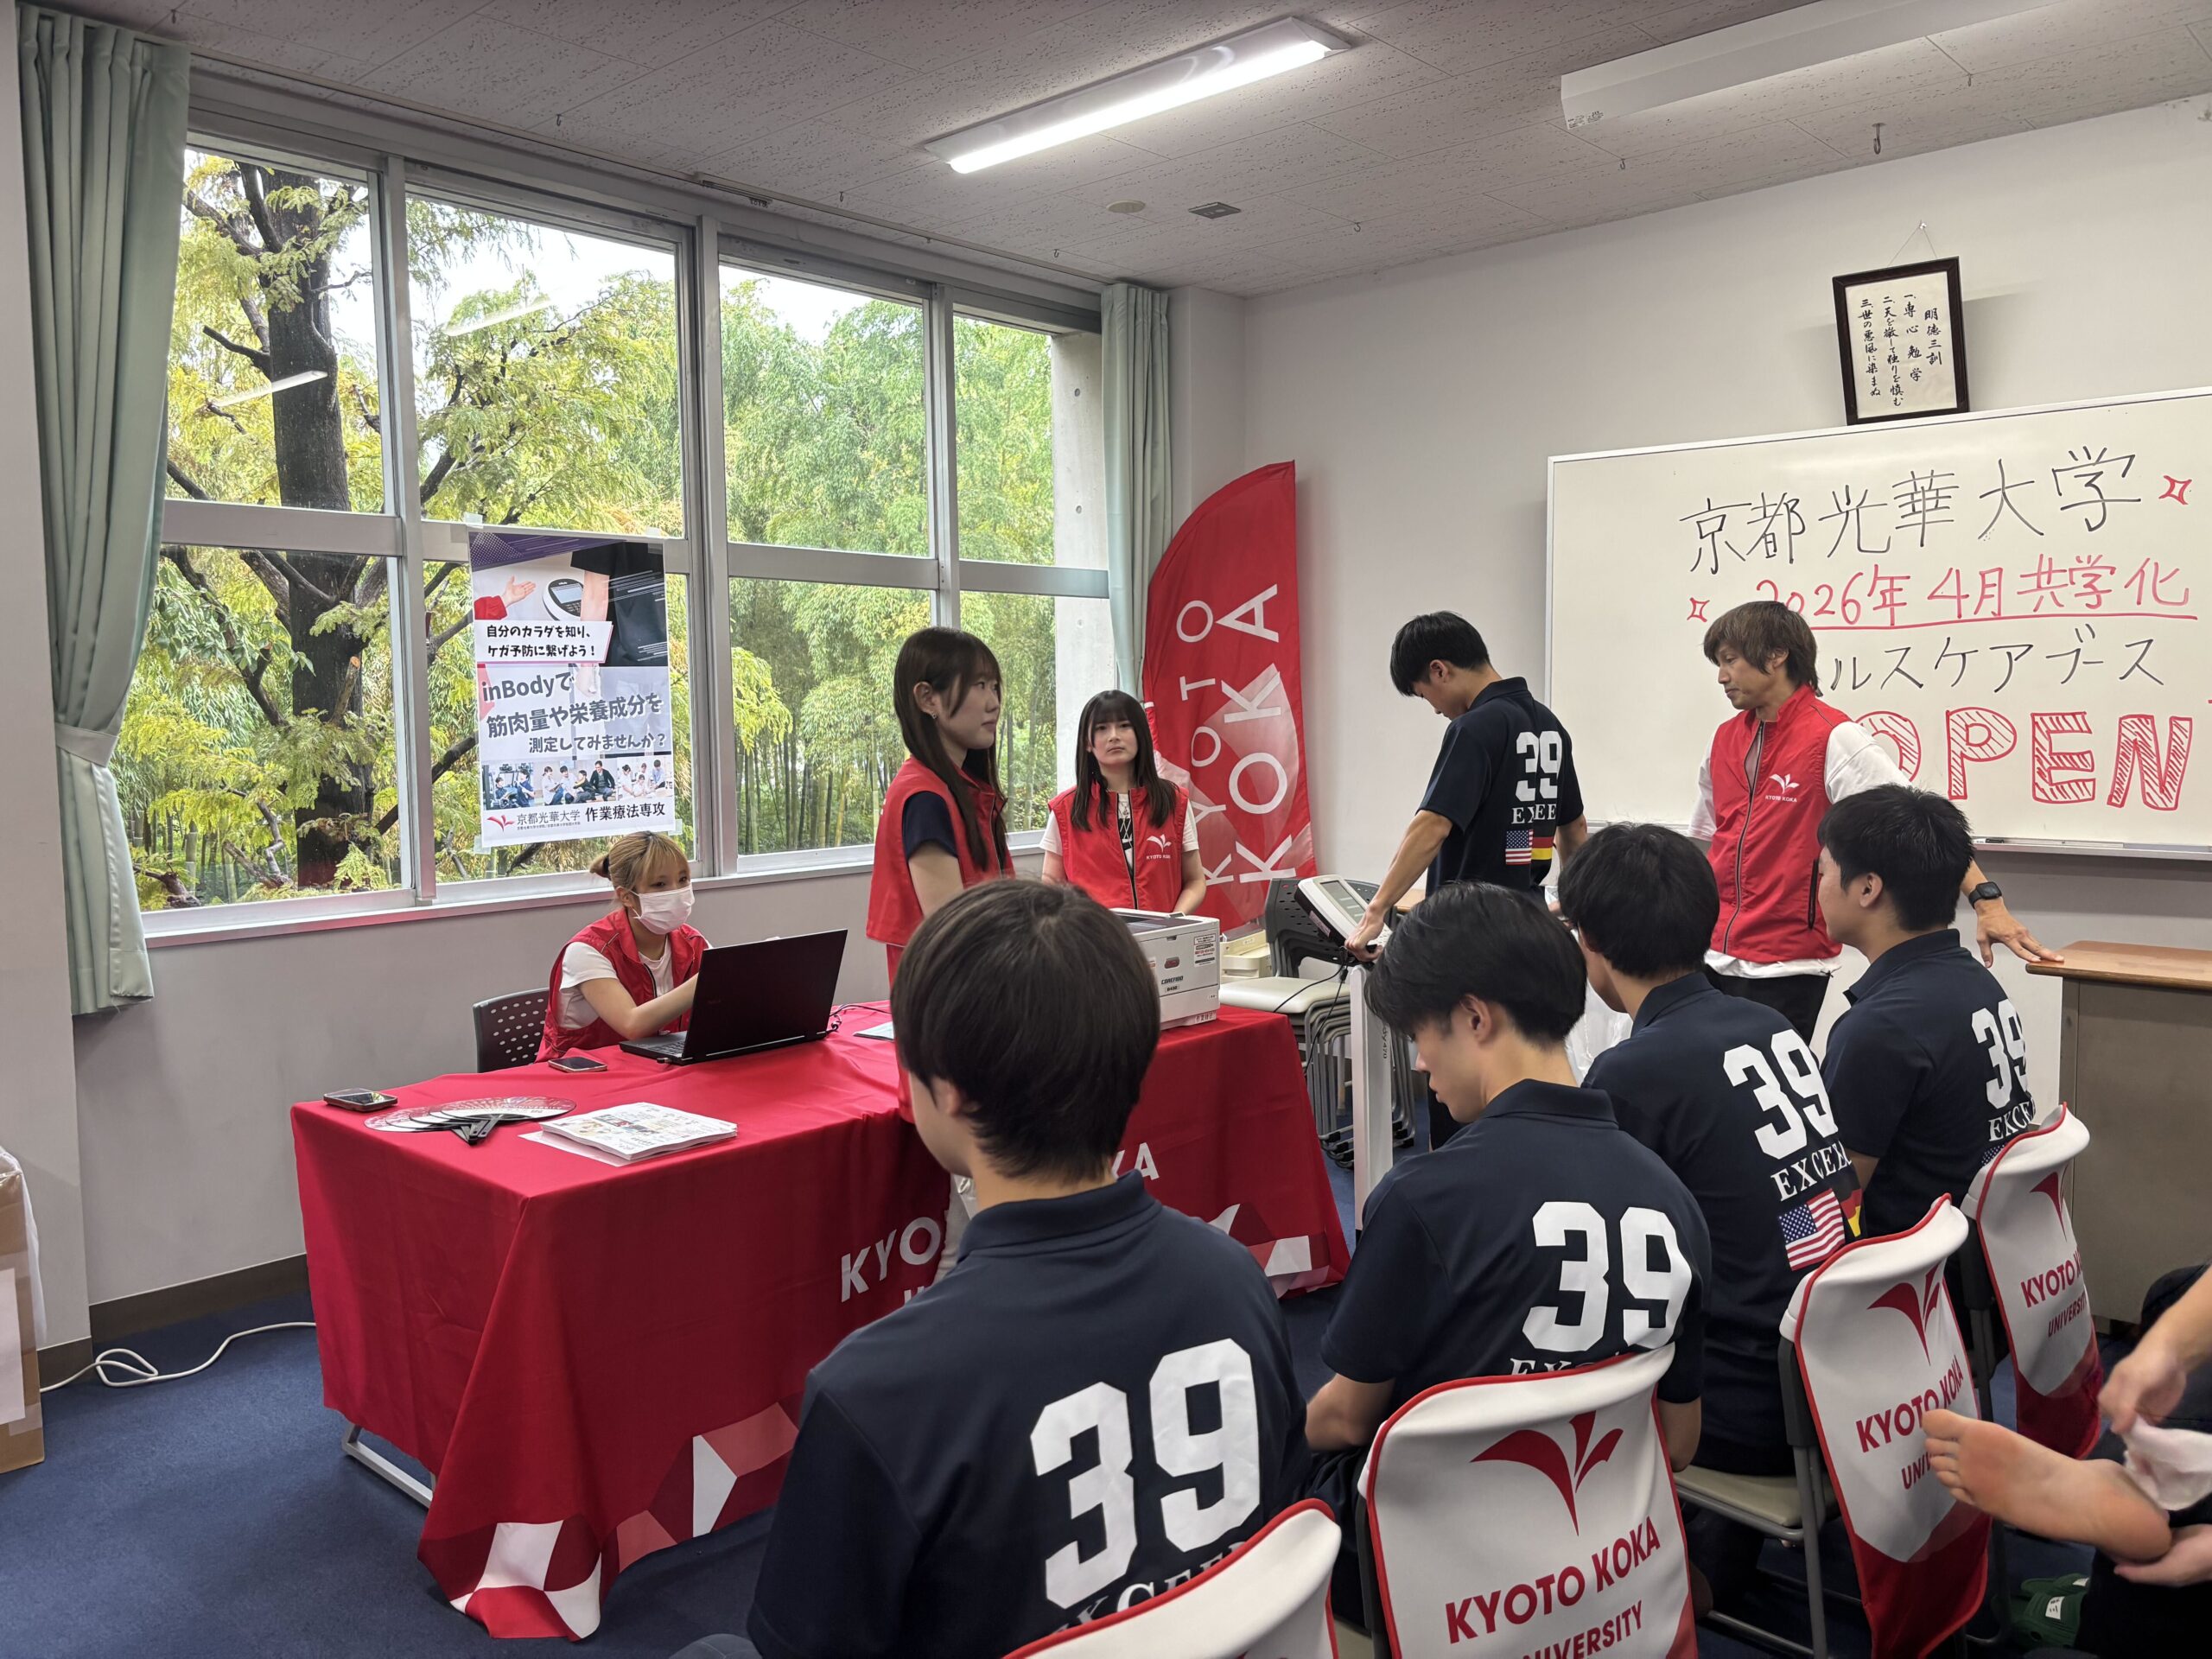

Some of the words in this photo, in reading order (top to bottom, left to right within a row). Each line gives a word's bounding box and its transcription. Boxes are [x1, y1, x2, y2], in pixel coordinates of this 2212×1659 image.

[1679, 445, 2142, 575] 京都光華大学
[486, 624, 590, 639] 自分のカラダを知り、
[1815, 623, 2164, 697] ルスケアブース
[481, 671, 575, 702] inBodyで
[486, 692, 663, 739] 筋肉量や栄養成分を
[529, 732, 666, 753] 測定してみませんか？
[1176, 600, 1235, 887] KYOTO
[1215, 583, 1297, 884] KOKA
[1515, 730, 1562, 802] 39
[516, 809, 582, 826] 京都光華大学
[585, 801, 666, 823] 作業療法専攻
[1722, 1028, 1839, 1160] 39
[1971, 998, 2028, 1109] 39
[841, 1217, 941, 1303] KYO
[1522, 1201, 1693, 1352] 39
[2020, 1259, 2075, 1308] KYOTO
[1856, 1389, 1940, 1453] KYOTO
[1939, 1355, 1964, 1409] KOKA
[1030, 1338, 1261, 1610] 39
[1445, 1566, 1586, 1645] KYOTO
[1591, 1516, 1661, 1593] KOKA
